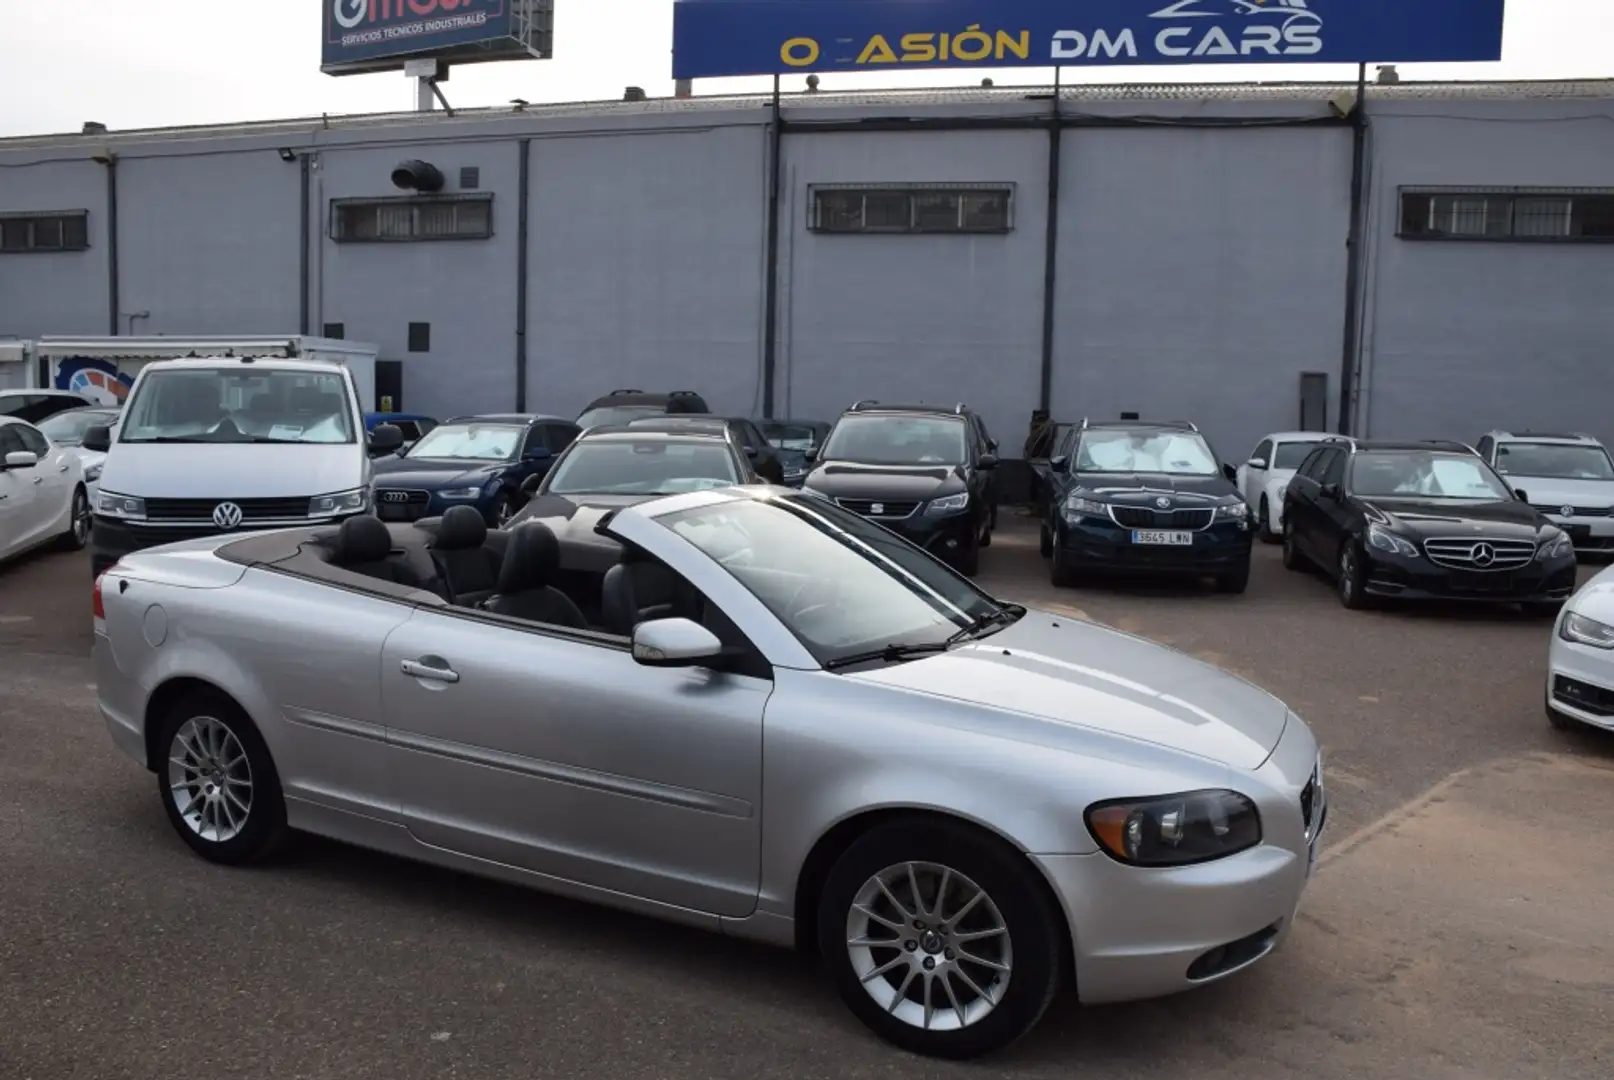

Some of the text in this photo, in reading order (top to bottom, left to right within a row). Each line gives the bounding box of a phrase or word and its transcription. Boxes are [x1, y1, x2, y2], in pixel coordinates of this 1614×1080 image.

[341, 29, 382, 46] SERVICIOS
[425, 11, 487, 32] INDUSTRIALES
[779, 24, 1323, 66] OASIÓN DM CARS
